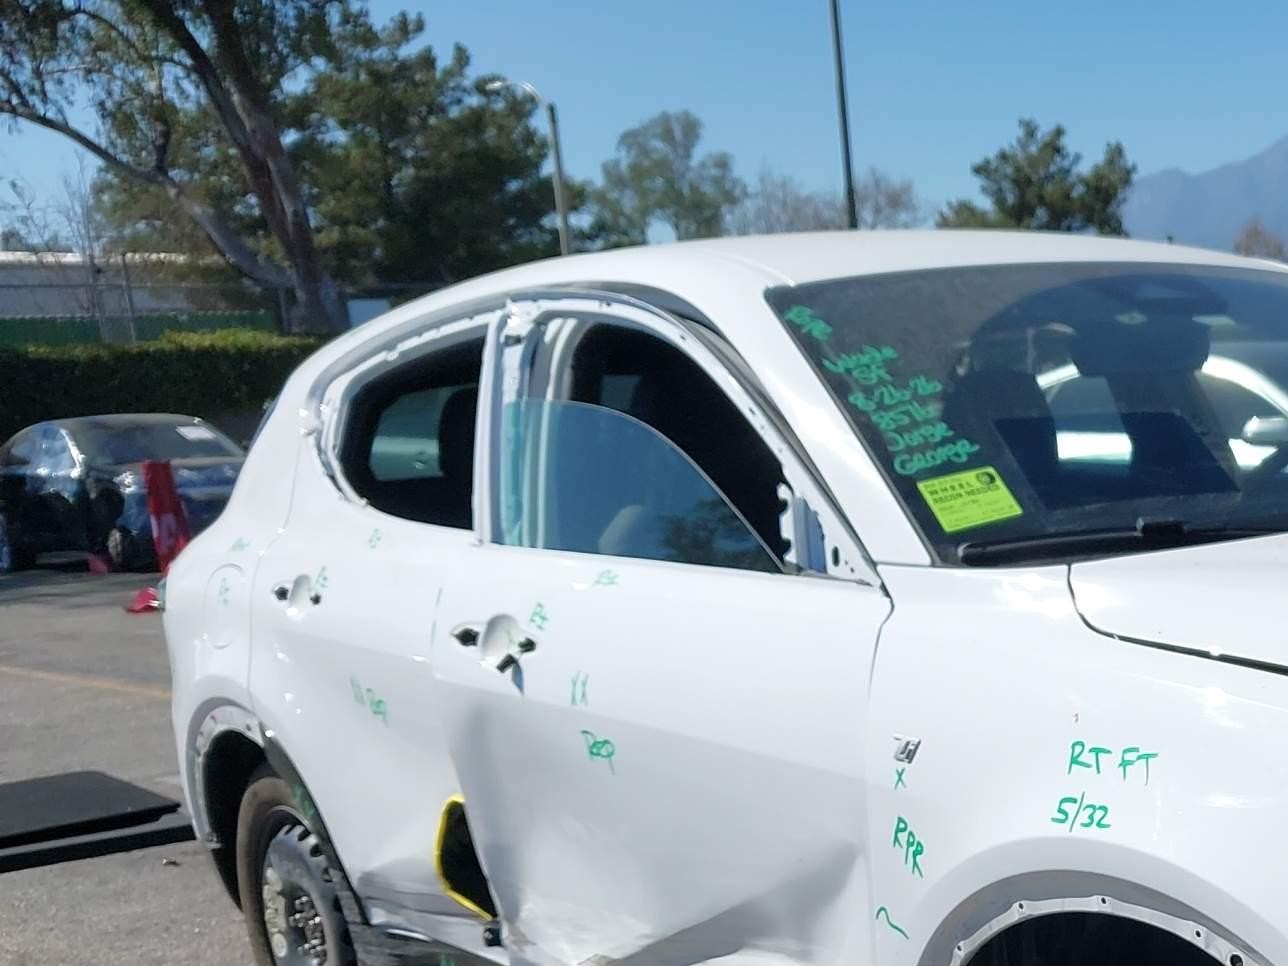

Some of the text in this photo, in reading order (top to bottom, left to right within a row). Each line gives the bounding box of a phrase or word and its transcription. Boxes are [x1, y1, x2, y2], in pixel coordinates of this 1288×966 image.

[1067, 739, 1159, 786] RT FT
[1050, 791, 1112, 833] 5/32
[893, 816, 924, 879] RPR
